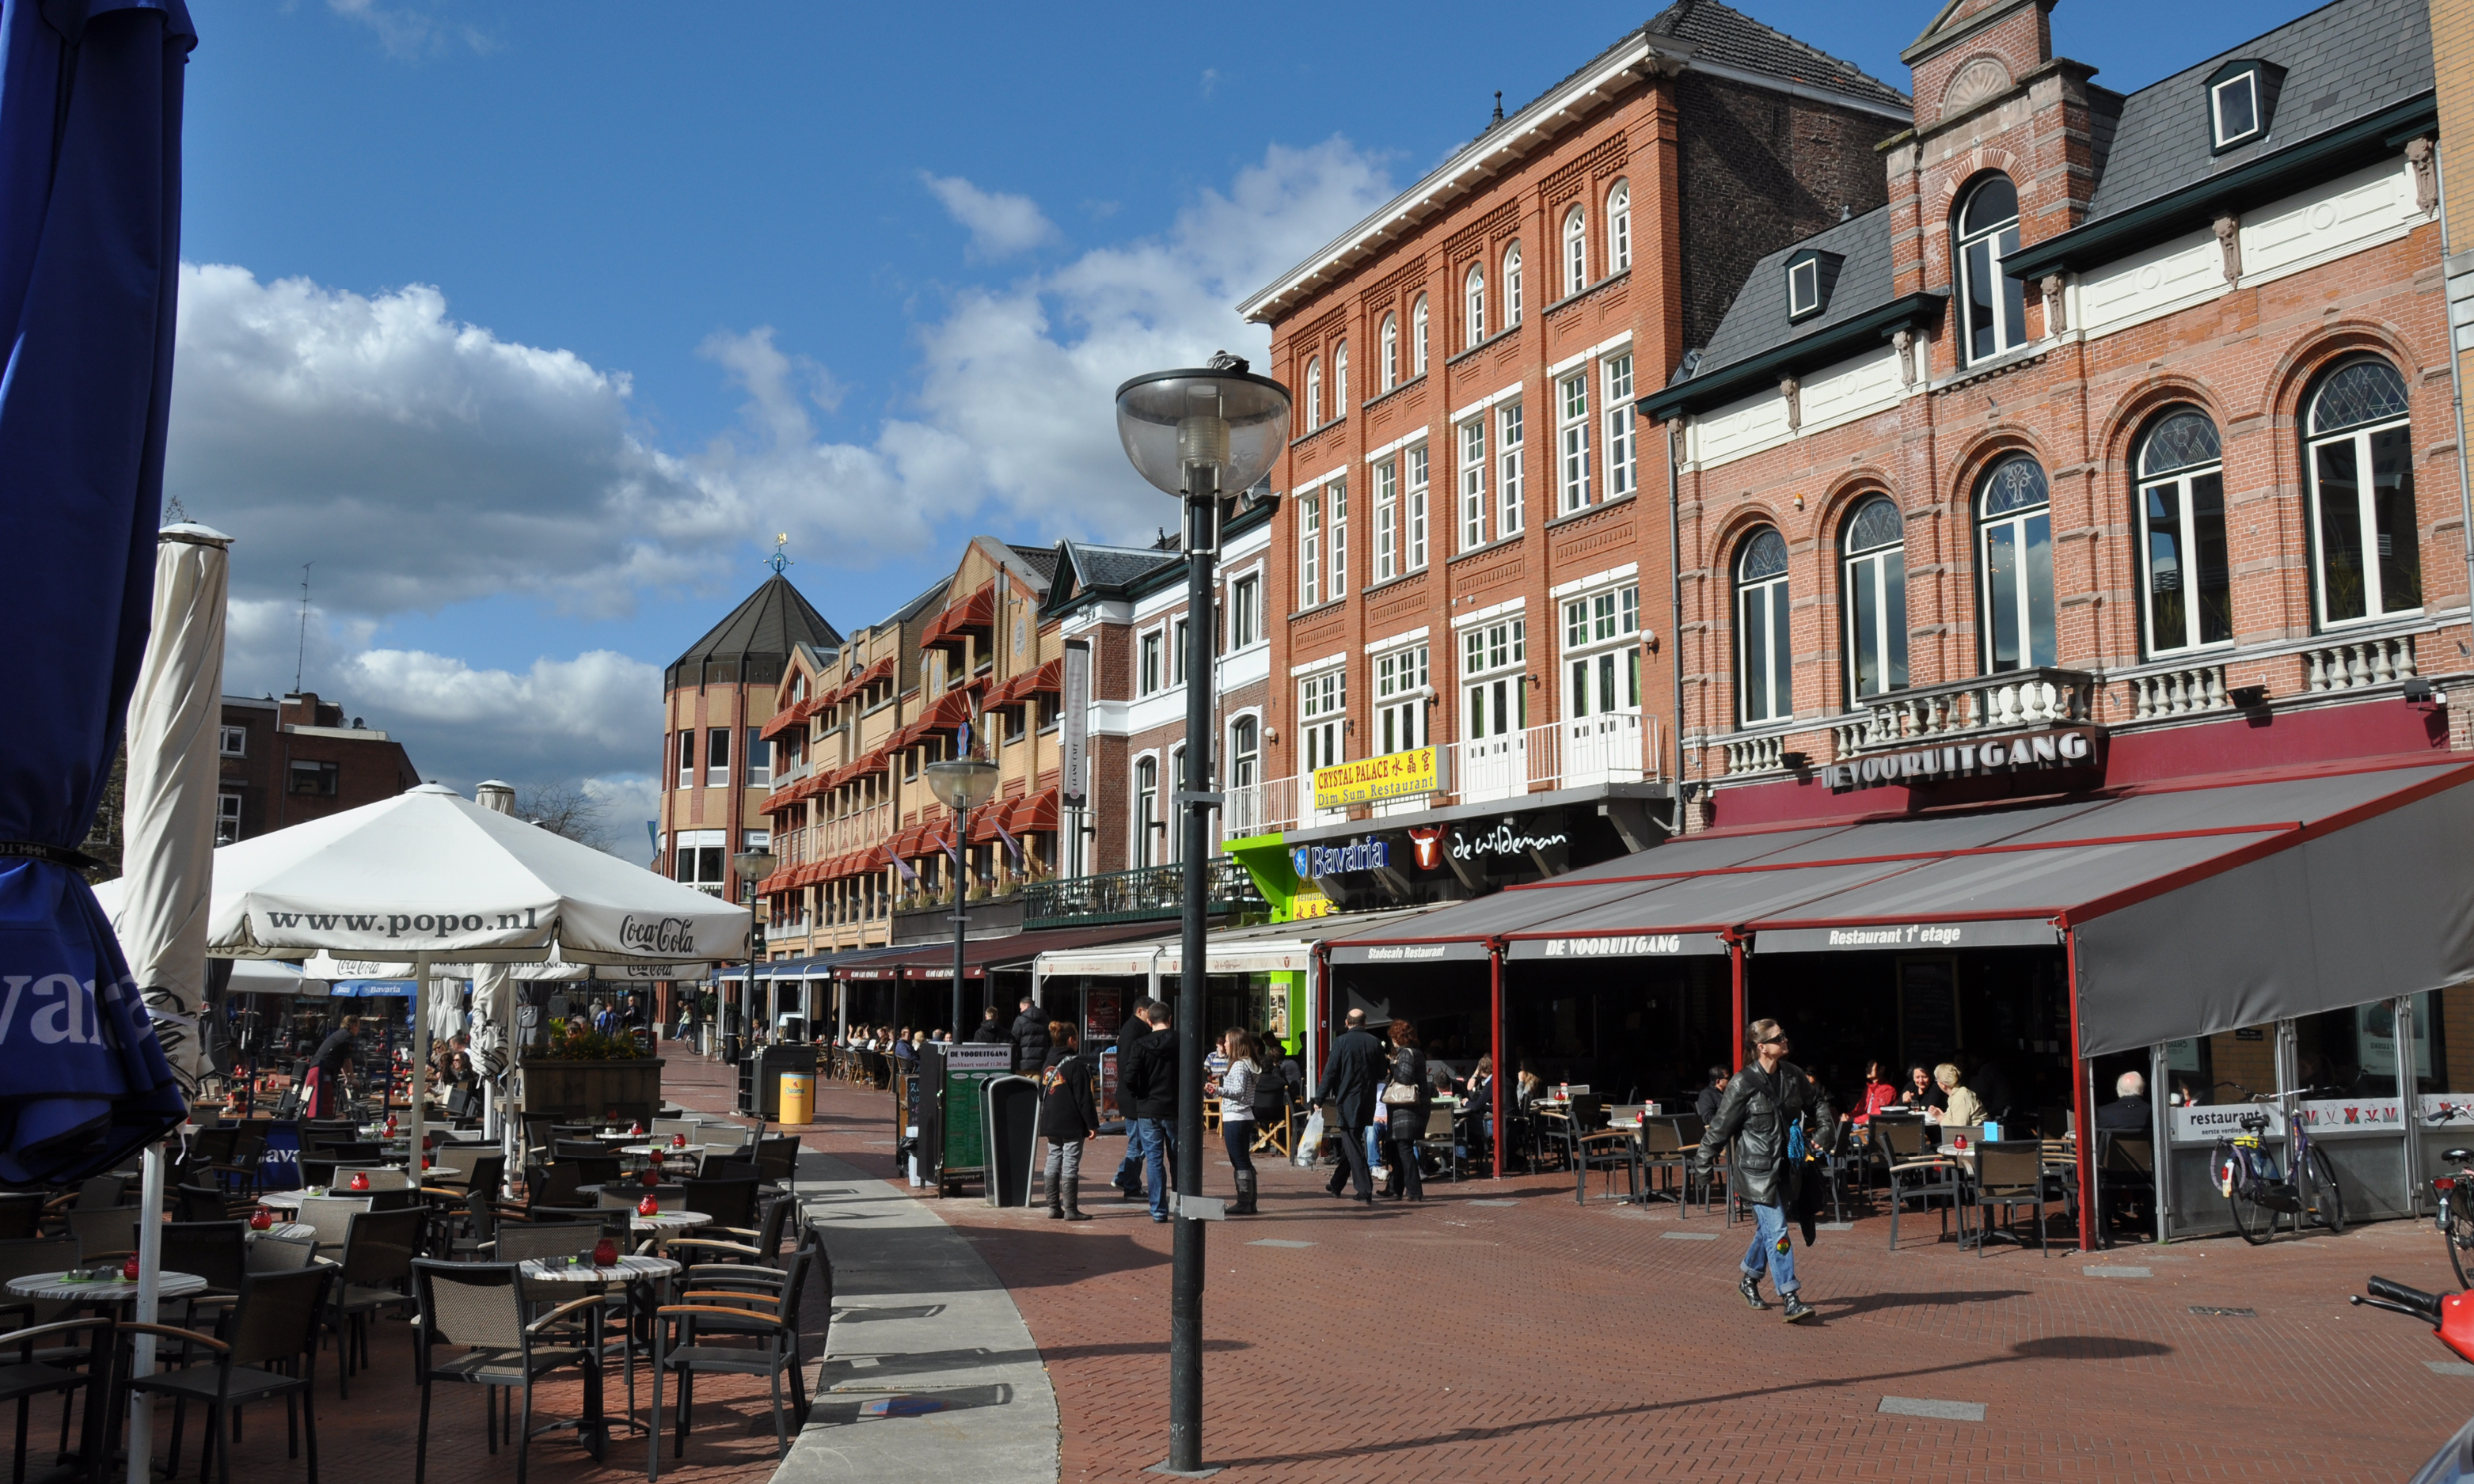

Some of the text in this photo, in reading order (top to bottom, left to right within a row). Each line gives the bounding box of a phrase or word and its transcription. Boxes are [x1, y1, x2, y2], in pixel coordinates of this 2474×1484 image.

[1318, 760, 1389, 790] CRYSTAL PALACE
[1822, 731, 2088, 789] DE VOORUITGANG
[1317, 775, 1434, 806] Dim Sum Restaurant
[1311, 835, 1384, 879] Bavaria
[1453, 832, 1472, 860] de
[267, 908, 538, 938] www.popo.nl
[619, 914, 694, 954] Coca-Cola
[1829, 928, 1902, 945] Restaurant
[1920, 927, 1961, 945] etage
[1367, 946, 1446, 959] Stadscafe Restaurant
[1545, 935, 1680, 956] DE VOORUITGANG
[371, 985, 401, 994] Bavaria
